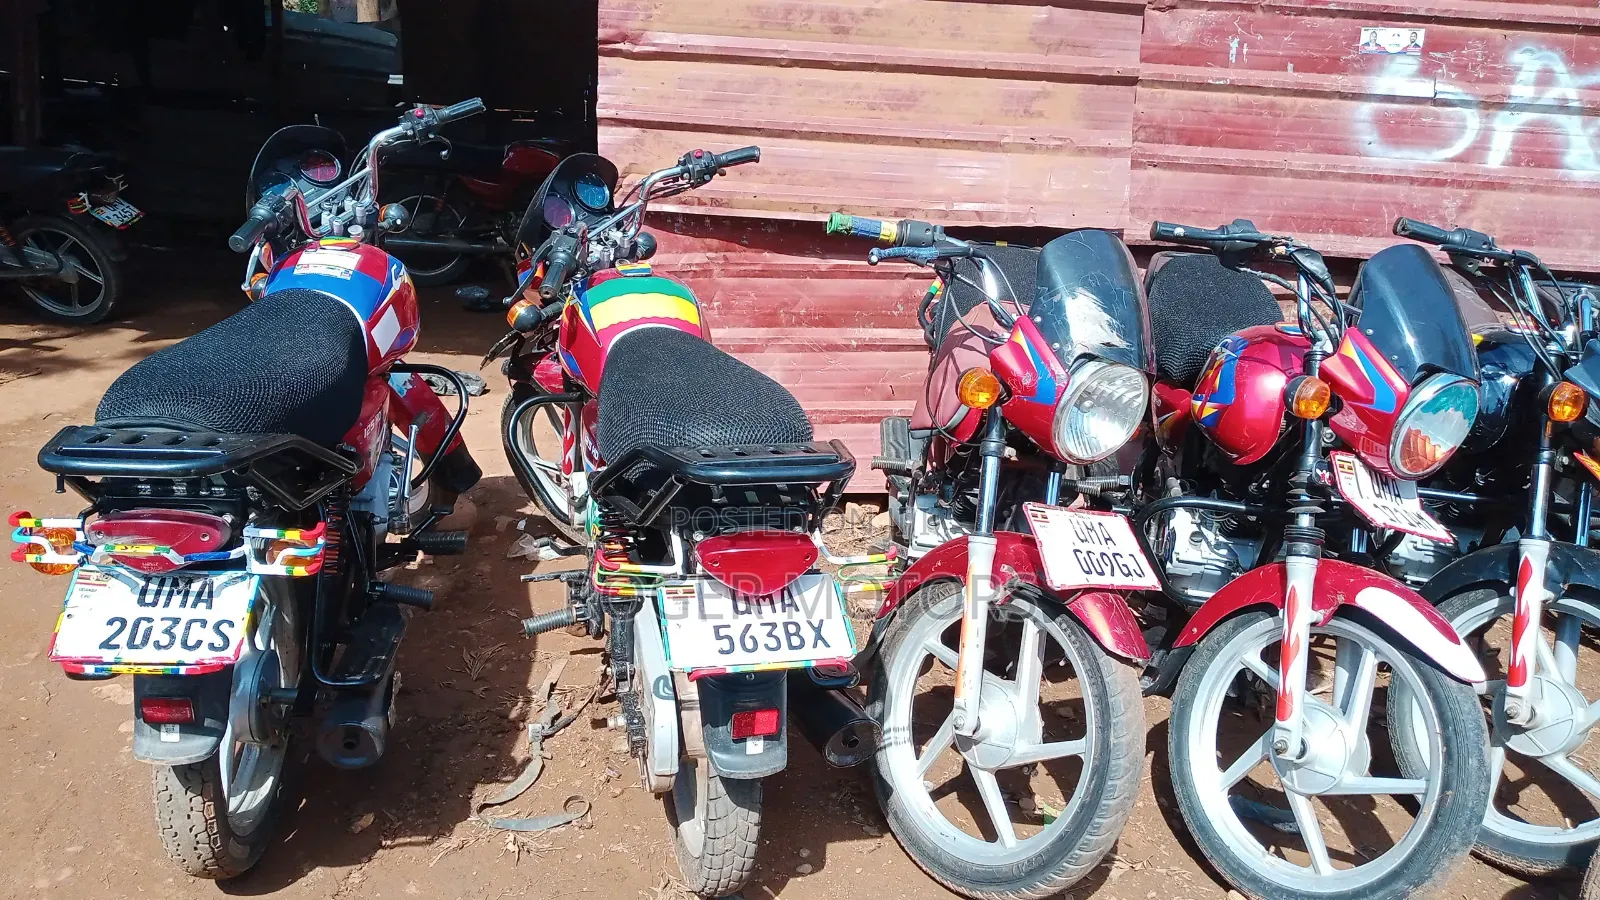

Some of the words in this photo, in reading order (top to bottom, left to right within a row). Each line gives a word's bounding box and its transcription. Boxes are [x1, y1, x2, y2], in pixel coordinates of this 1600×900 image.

[1369, 470, 1403, 504] UMA
[1069, 519, 1116, 547] UMA
[137, 577, 214, 610] UMA
[731, 586, 800, 616] UMA
[99, 616, 235, 652] 203CS
[712, 619, 831, 655] 563BX
